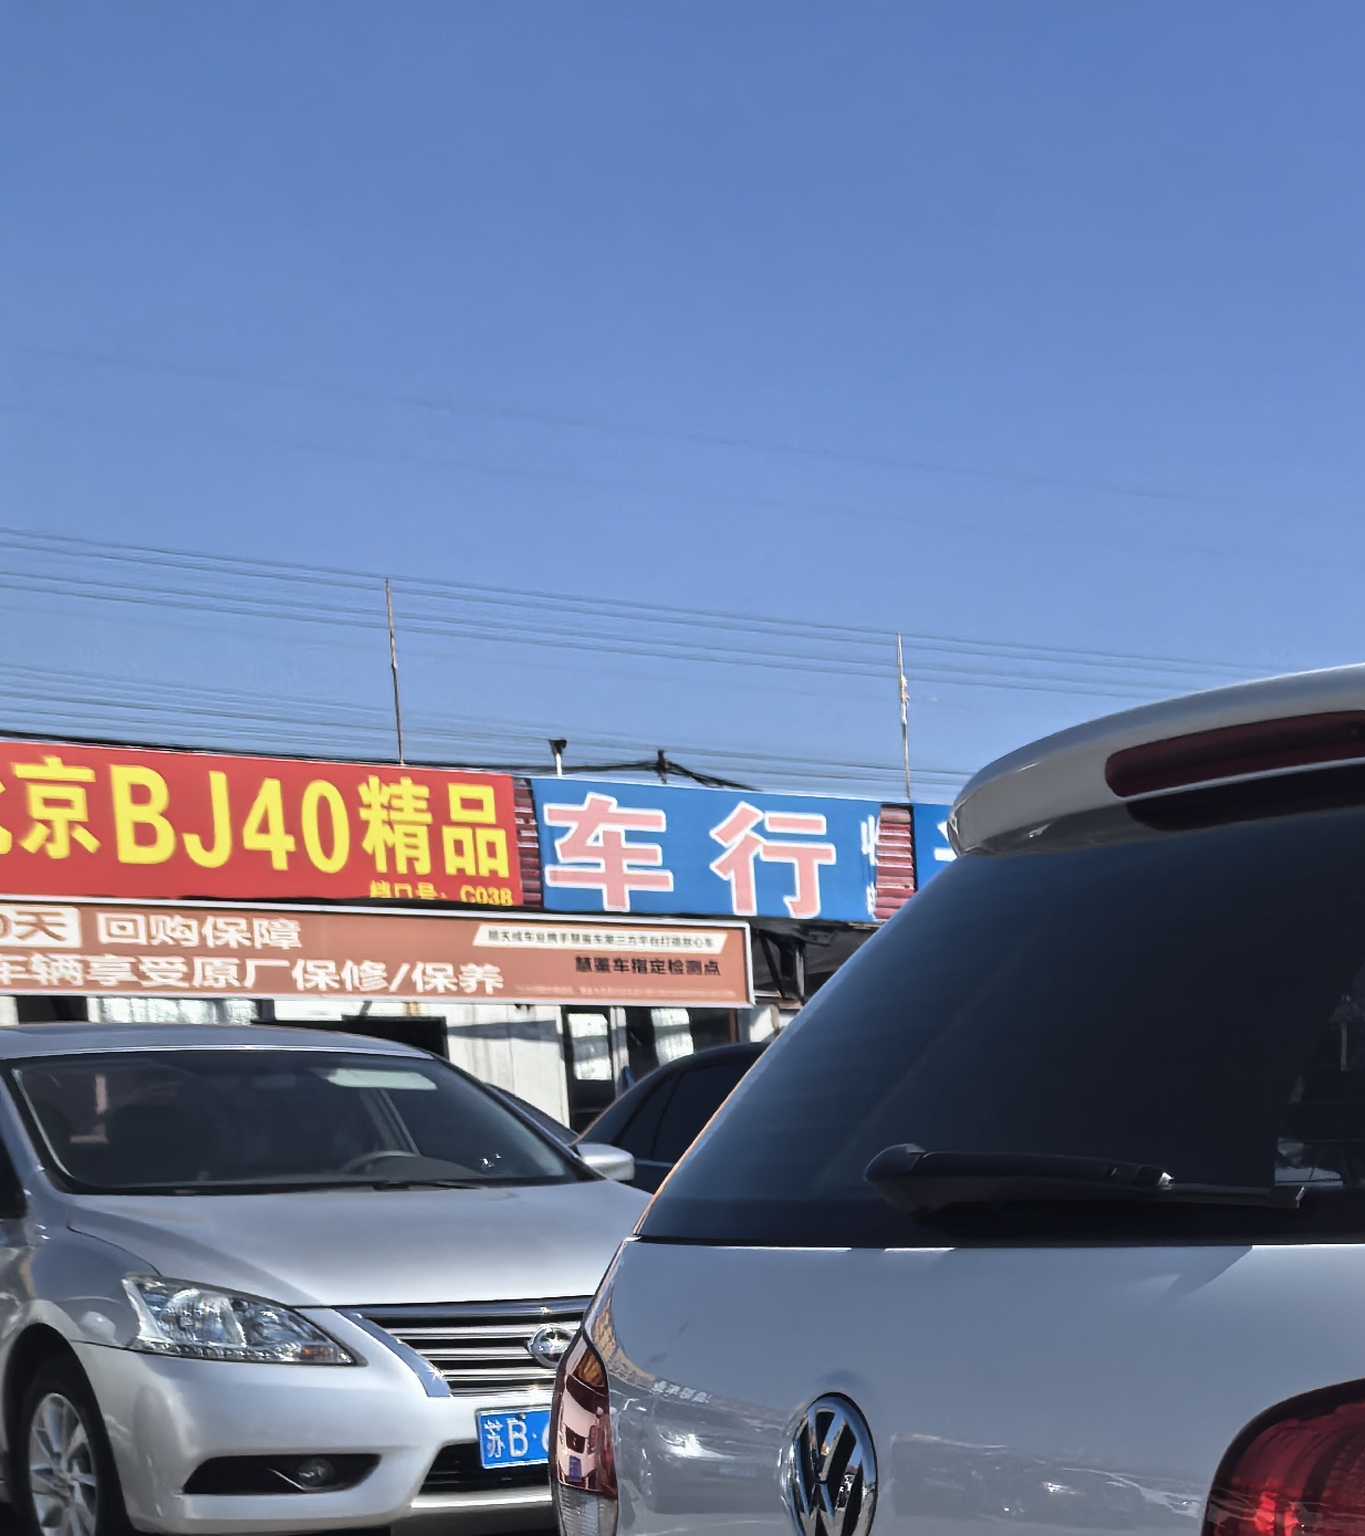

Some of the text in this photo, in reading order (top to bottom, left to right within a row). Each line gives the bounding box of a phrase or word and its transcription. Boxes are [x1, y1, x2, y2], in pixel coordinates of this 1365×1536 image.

[0, 755, 511, 879] 京BJ40精品
[95, 910, 304, 951] 回购保障
[484, 1417, 549, 1458] 苏B·
